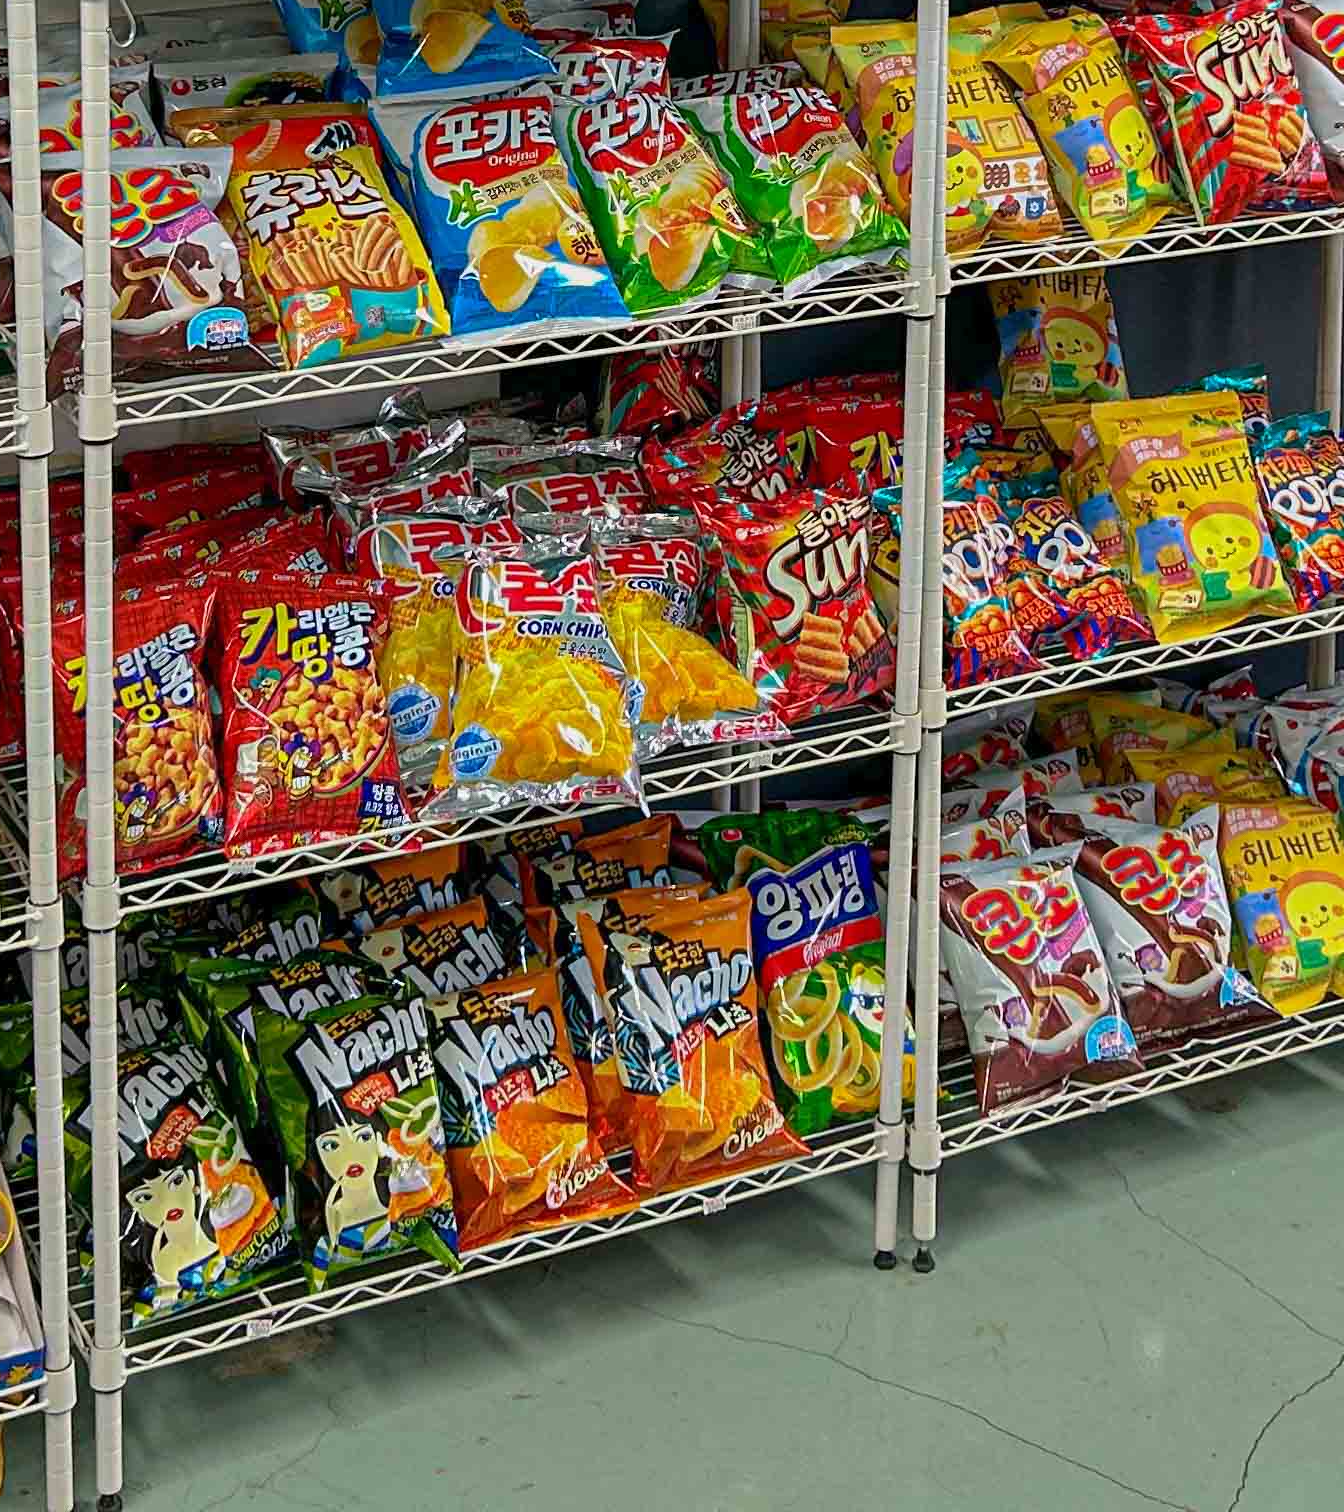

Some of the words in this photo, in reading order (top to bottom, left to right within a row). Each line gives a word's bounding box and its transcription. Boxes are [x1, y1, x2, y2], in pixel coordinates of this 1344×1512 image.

[1217, 11, 1279, 53] 돌아온
[191, 73, 227, 92] 농심
[1196, 39, 1294, 127] Sun
[488, 149, 540, 166] Original
[797, 495, 870, 548] 돌아온
[626, 576, 666, 598] CORN
[766, 528, 869, 638] Sun
[516, 619, 563, 638] CORN
[388, 696, 439, 730] riginal
[756, 849, 868, 941] 양파링
[408, 925, 457, 966] 도도한
[654, 940, 706, 973] 도도한
[271, 961, 321, 987] 도도한
[622, 951, 753, 1051] Nacho
[706, 999, 752, 1041] 나초
[325, 1007, 376, 1040] 도도한
[298, 998, 429, 1103] Nacho
[438, 1007, 557, 1091] Nacho
[391, 1050, 435, 1092] 나초
[530, 1056, 571, 1090] 나초
